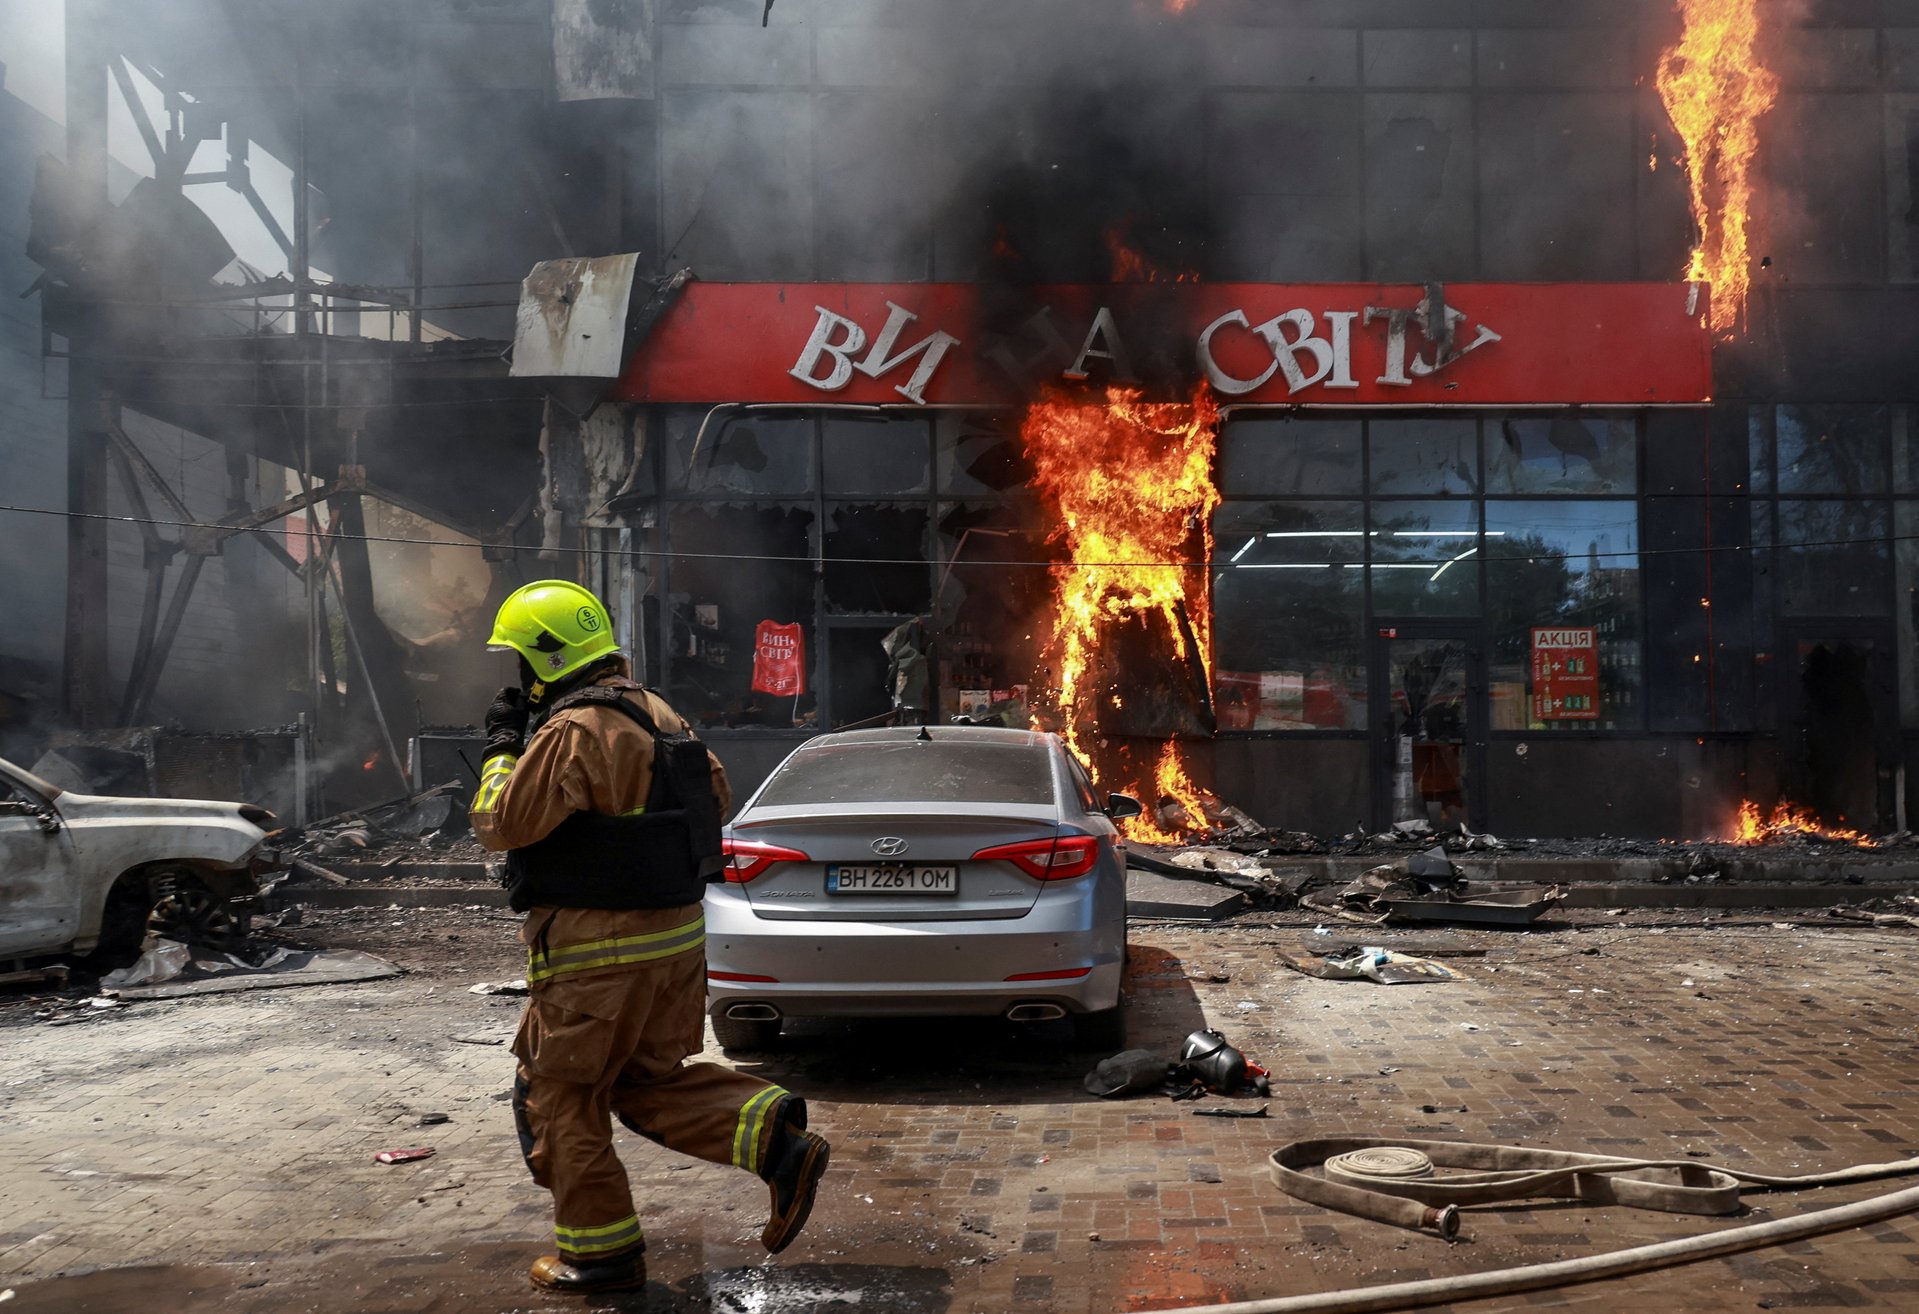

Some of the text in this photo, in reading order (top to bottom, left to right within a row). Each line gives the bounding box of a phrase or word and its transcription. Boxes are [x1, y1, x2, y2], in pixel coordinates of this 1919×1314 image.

[1197, 300, 1502, 396] СВІТУ
[583, 609, 591, 618] 6
[588, 619, 597, 629] 11
[1538, 632, 1589, 647] АКЦІЯ
[839, 869, 950, 888] BH 2261 OM
[759, 890, 816, 898] SONATA
